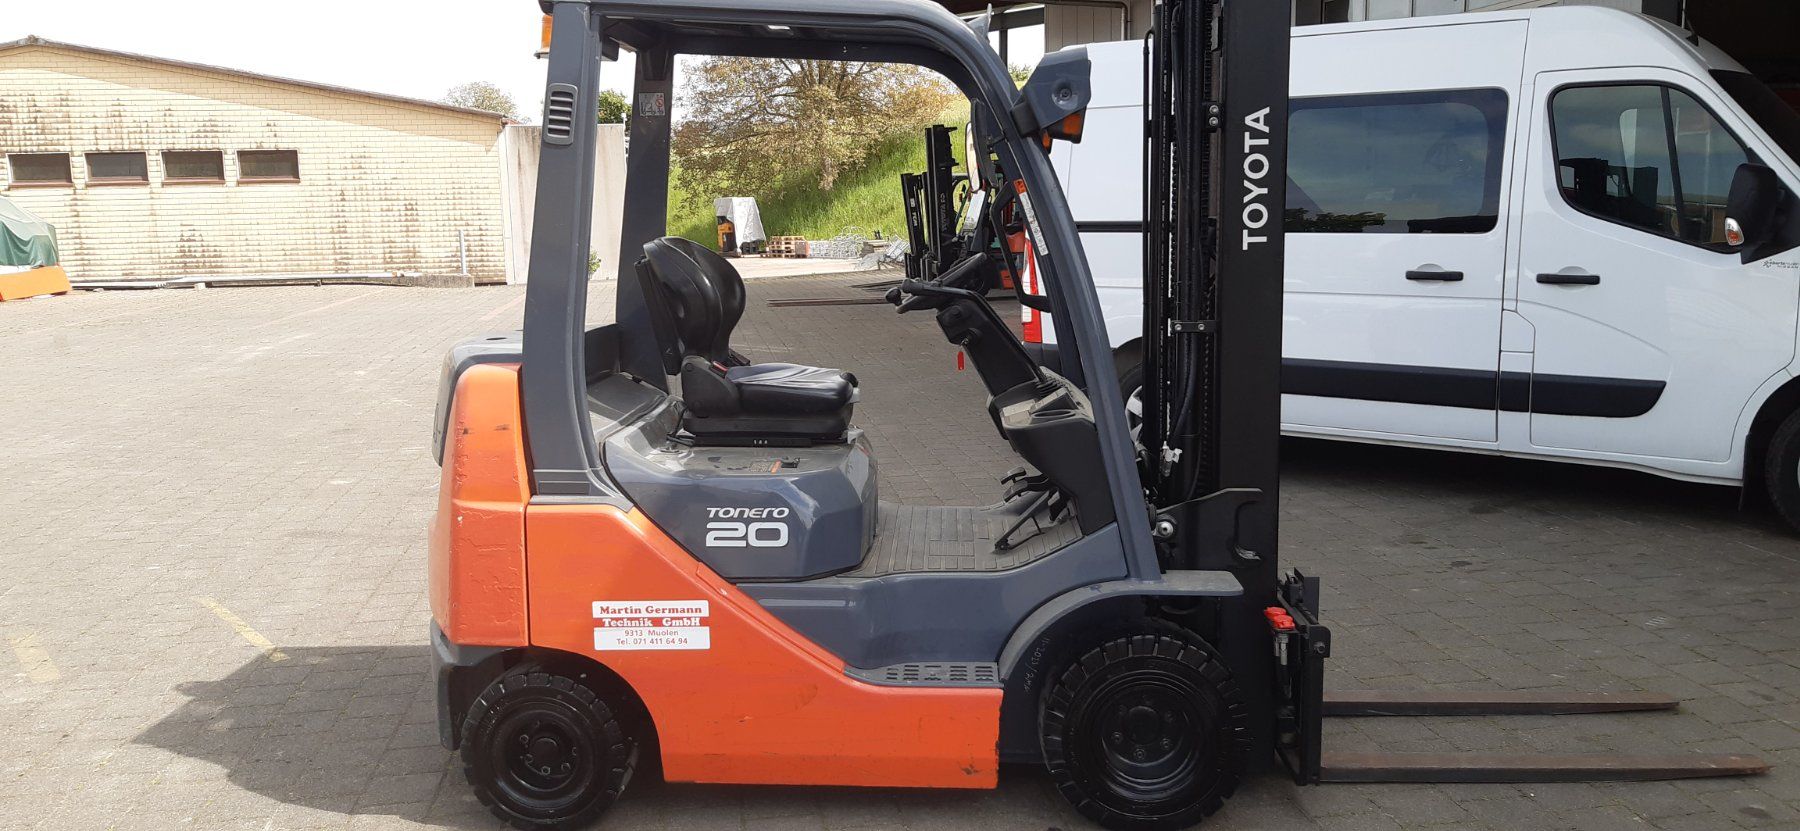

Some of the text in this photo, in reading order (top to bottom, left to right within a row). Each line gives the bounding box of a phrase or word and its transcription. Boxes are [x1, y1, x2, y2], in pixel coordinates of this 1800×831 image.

[1242, 107, 1270, 250] TOYOTA
[705, 522, 789, 547] 20
[600, 605, 702, 614] Martin Germann
[602, 617, 701, 626] Technik GmbH
